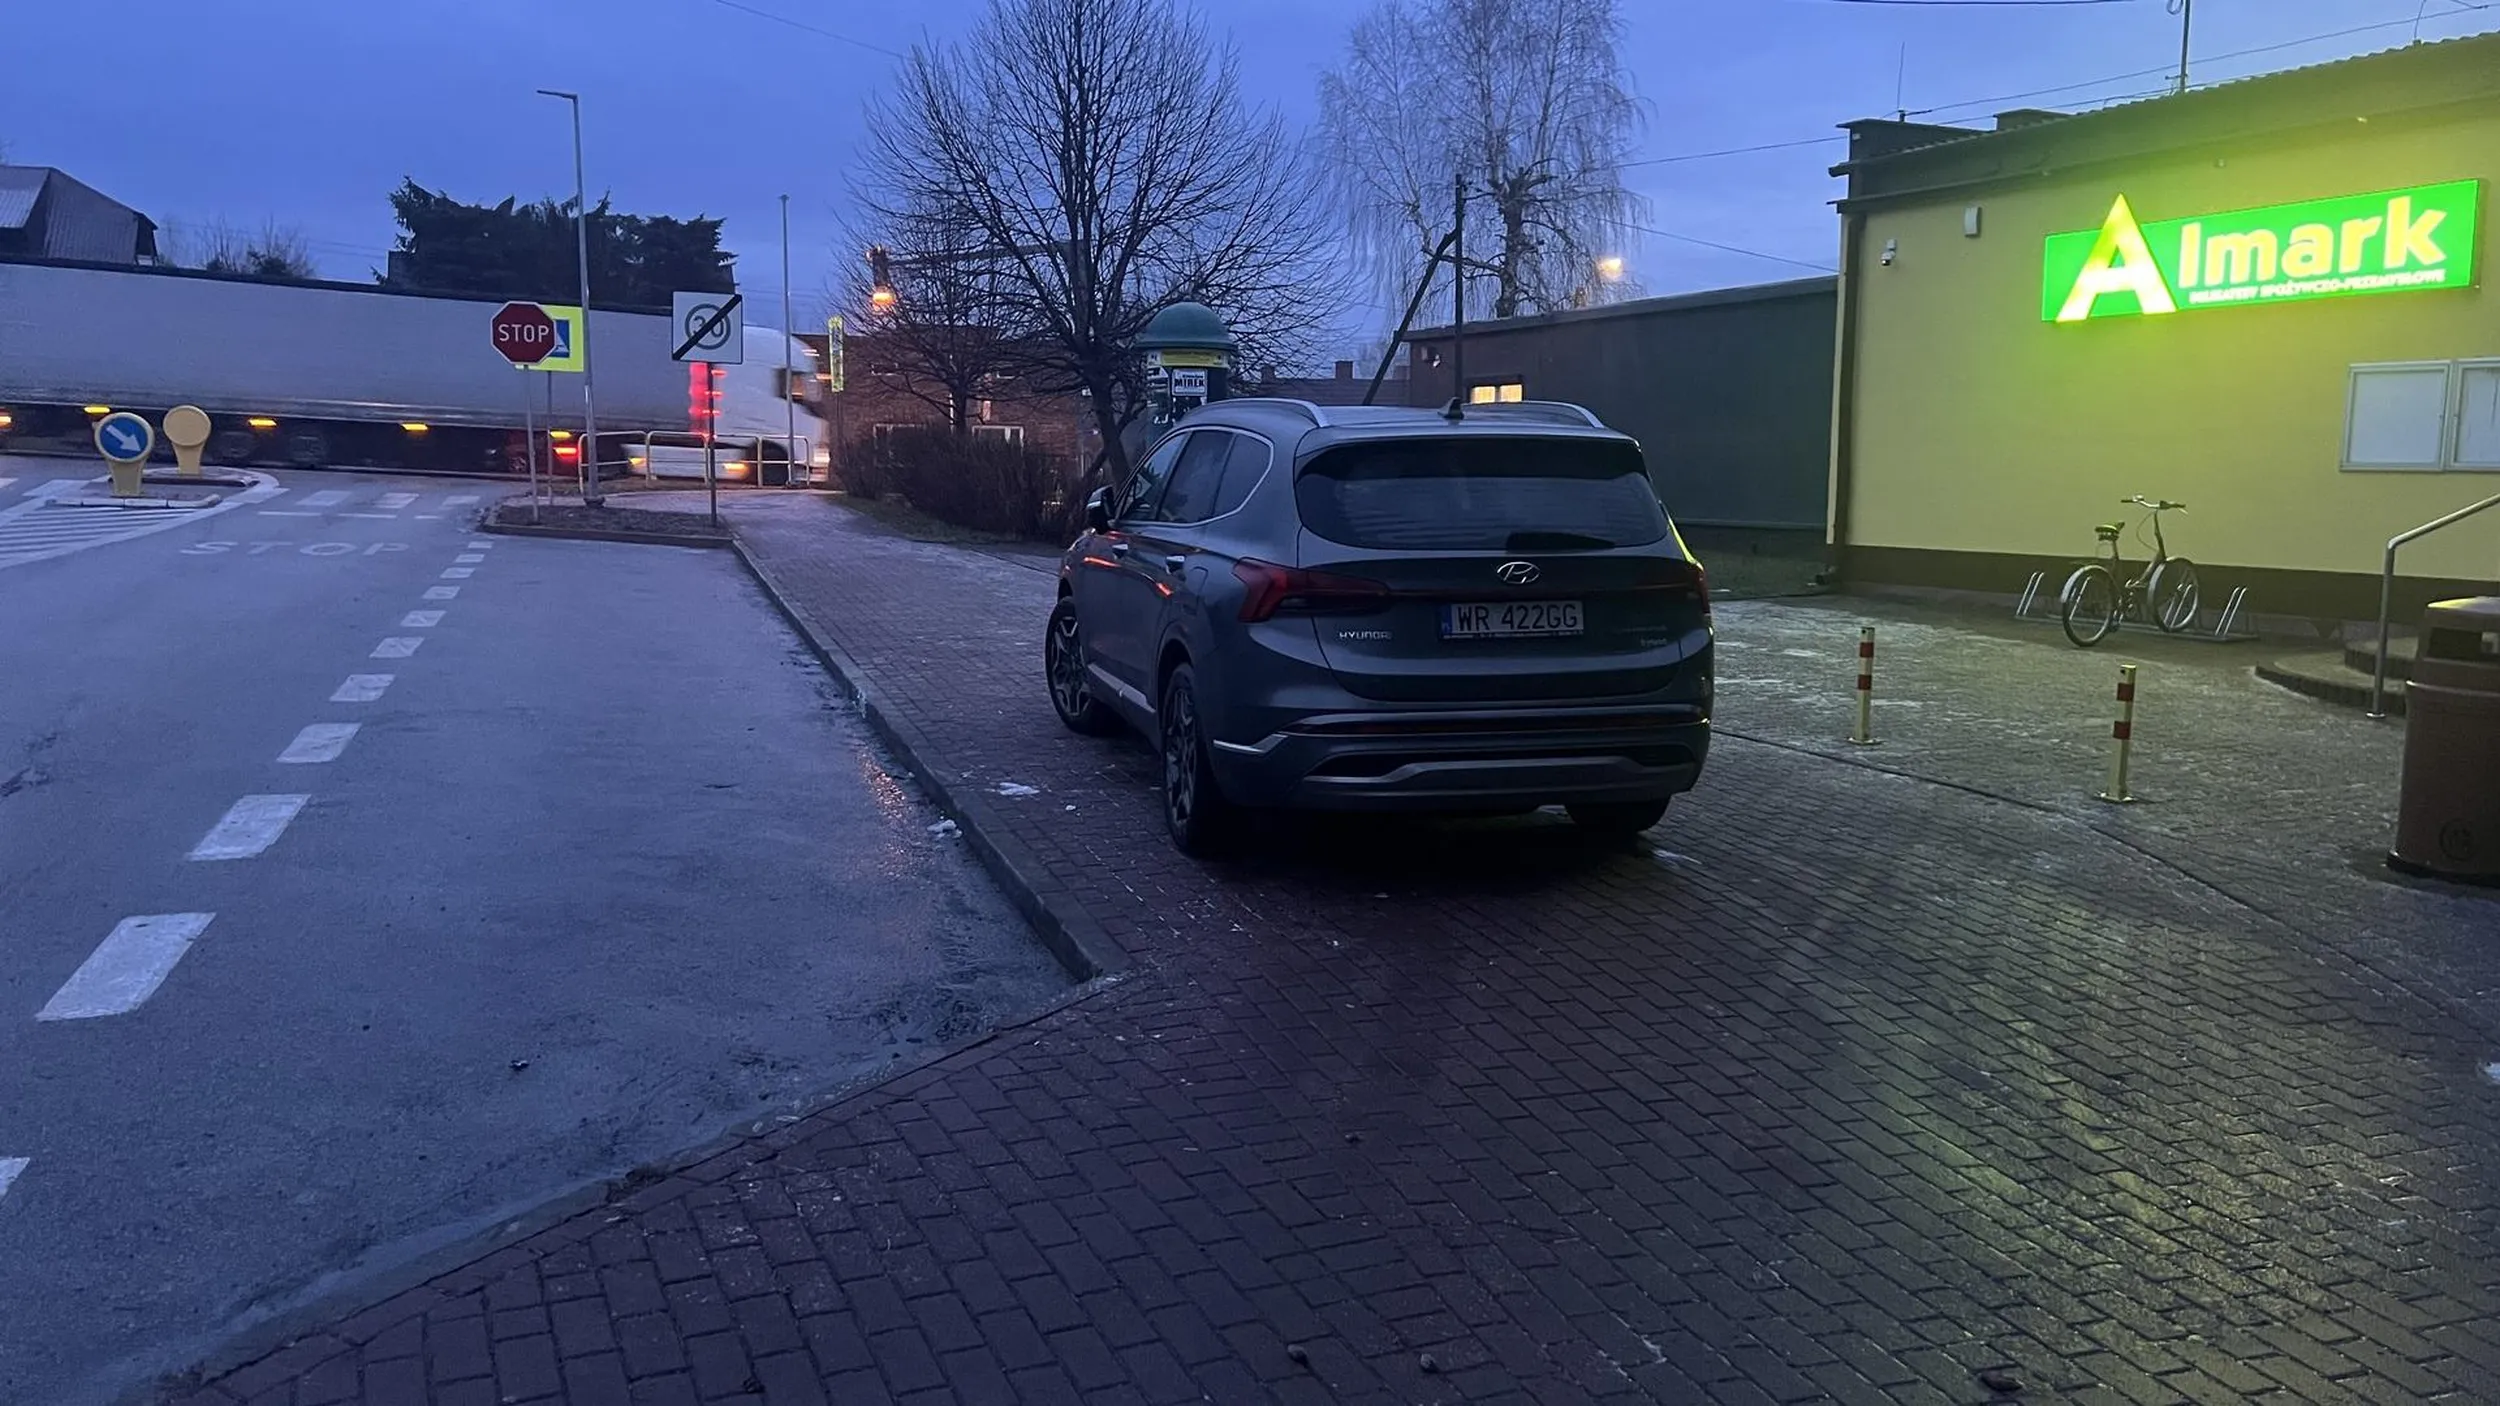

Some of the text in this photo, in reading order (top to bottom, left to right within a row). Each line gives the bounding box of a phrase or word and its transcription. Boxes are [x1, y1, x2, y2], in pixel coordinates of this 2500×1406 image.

[2056, 193, 2447, 323] Almark
[498, 323, 549, 343] STOP
[692, 314, 725, 339] 30
[180, 541, 410, 556] STOP
[1457, 603, 1578, 632] WR 422GG
